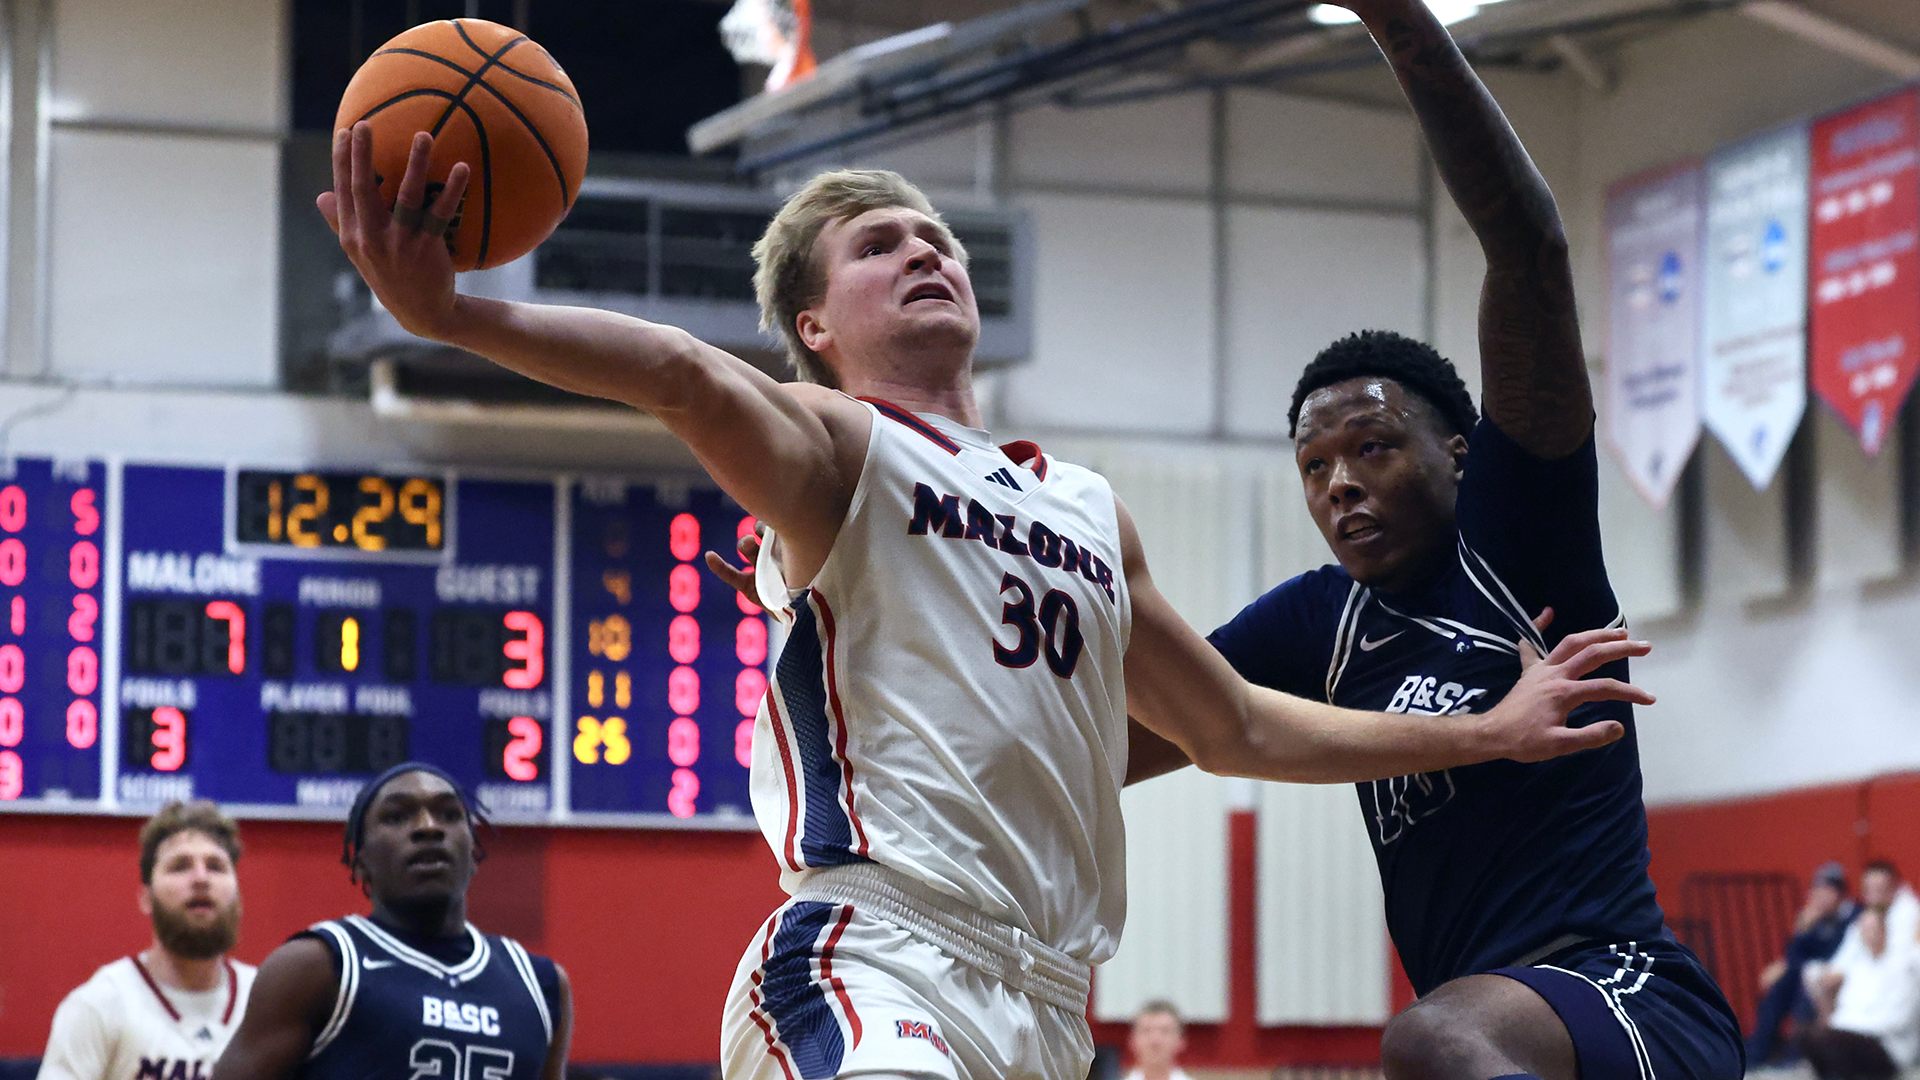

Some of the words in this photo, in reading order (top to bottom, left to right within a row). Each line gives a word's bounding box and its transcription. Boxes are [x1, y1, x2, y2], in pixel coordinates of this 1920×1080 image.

[71, 488, 99, 535] 5
[69, 541, 99, 589] 0
[908, 482, 1115, 606] MALONE
[127, 551, 260, 594] MALONE
[435, 566, 541, 602] GUEST
[68, 593, 98, 642] 2
[205, 601, 245, 675] 7
[993, 572, 1084, 679] 30
[341, 617, 359, 671] 1
[503, 611, 544, 689] 3
[67, 646, 98, 695] 0
[66, 699, 97, 749] 0
[151, 706, 186, 771] 3
[504, 717, 543, 781] 2
[668, 768, 700, 818] 2
[422, 996, 501, 1037] B&SC
